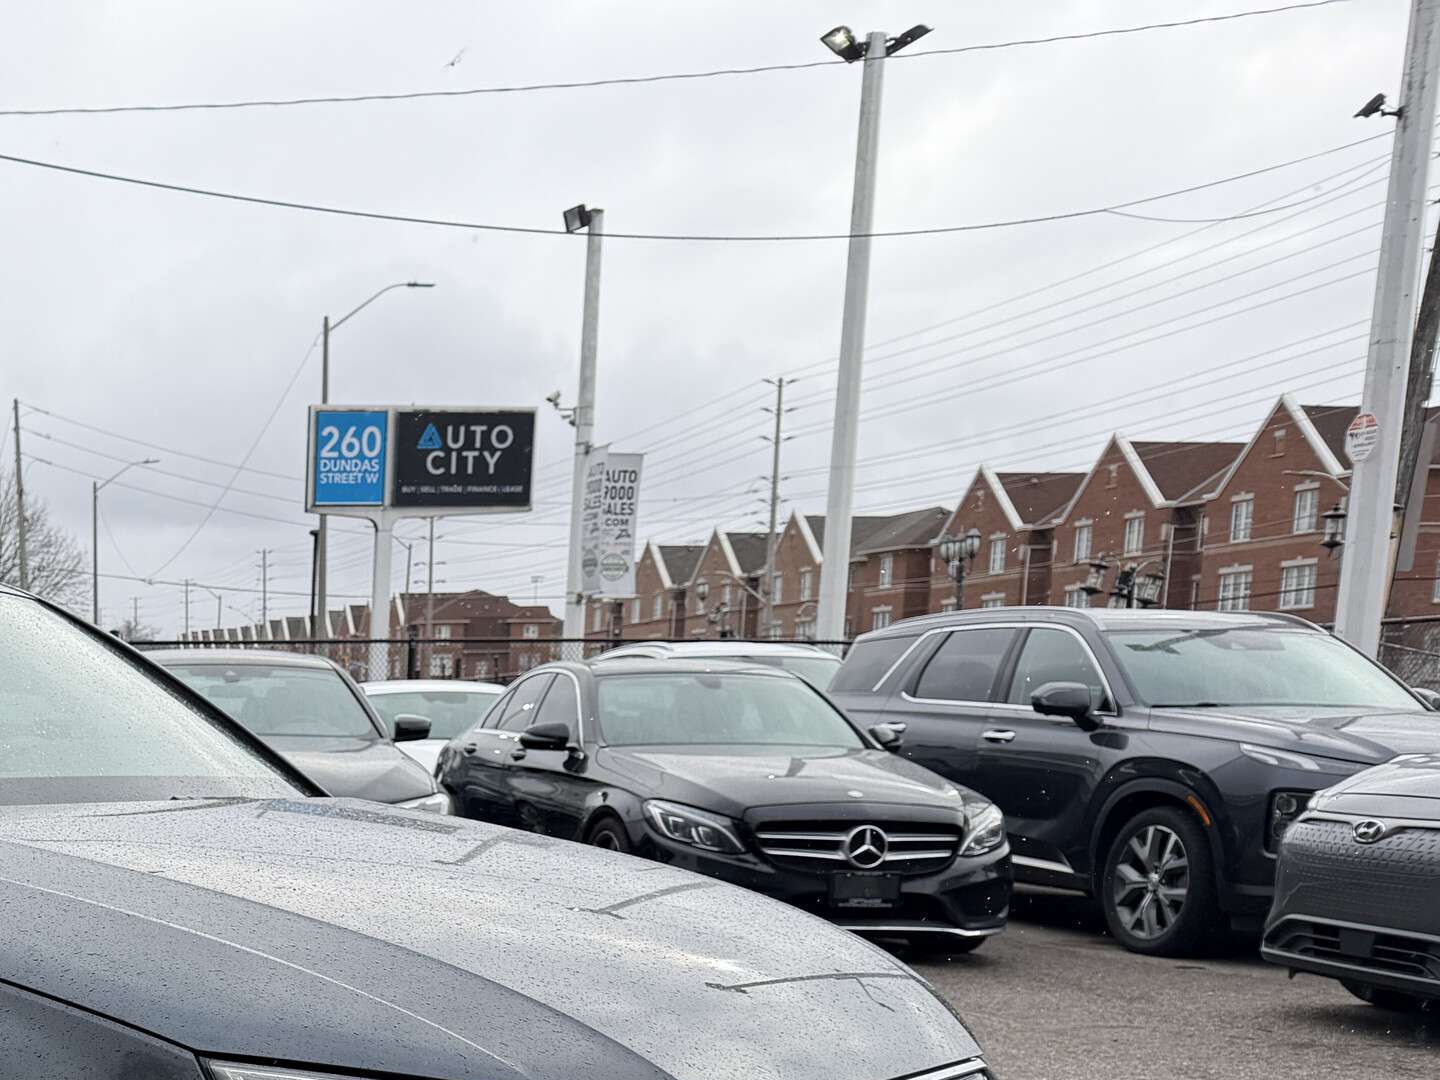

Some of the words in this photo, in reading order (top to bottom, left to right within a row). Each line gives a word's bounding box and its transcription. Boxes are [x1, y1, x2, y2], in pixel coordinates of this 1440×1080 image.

[319, 426, 381, 458] 260
[319, 459, 379, 472] DUNDAS
[425, 450, 502, 475] CITY
[319, 473, 362, 484] STREET
[365, 473, 379, 484] W
[605, 469, 638, 483] AUTO
